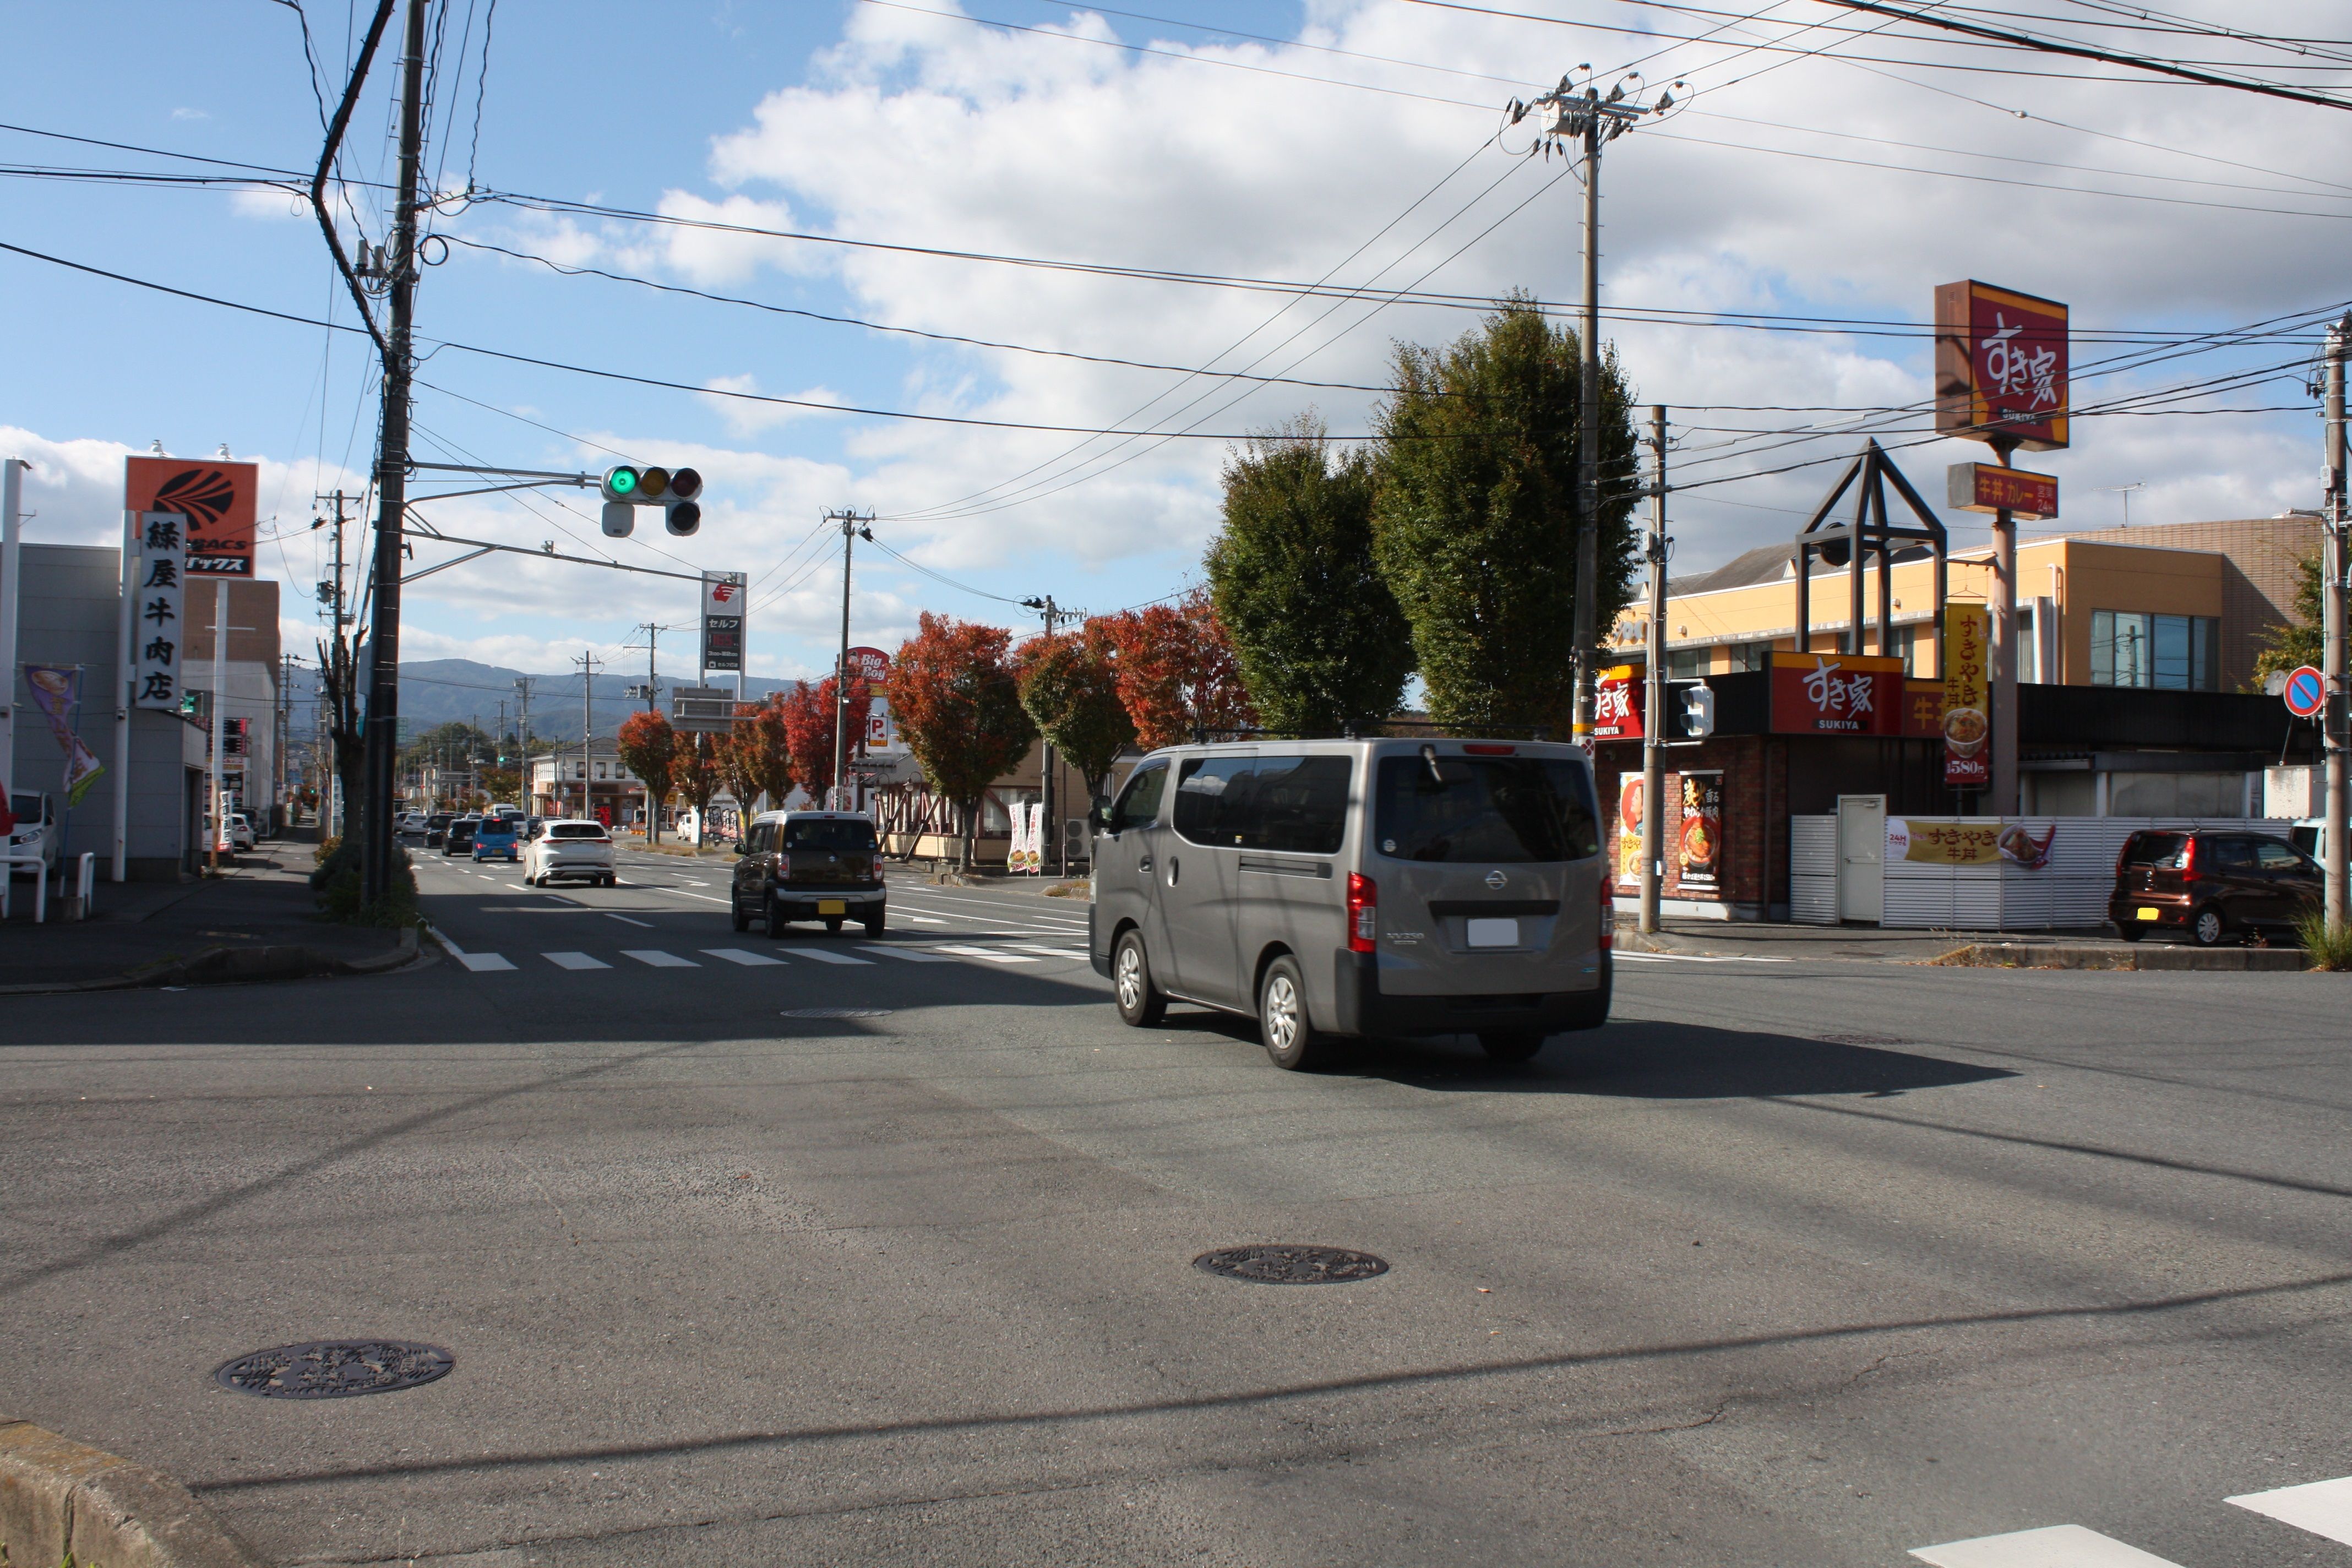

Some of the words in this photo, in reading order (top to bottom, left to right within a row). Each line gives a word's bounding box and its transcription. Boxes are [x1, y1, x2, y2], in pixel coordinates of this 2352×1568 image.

[1981, 312, 2057, 410] すき家
[2002, 409, 2037, 425] SUKIYA
[1979, 476, 2003, 502] 牛丼
[2007, 481, 2034, 504] カレー
[2038, 485, 2053, 498] 営業
[2038, 499, 2054, 513] 24H
[139, 521, 180, 700] 緑屋牛肉店
[709, 619, 738, 629] セルフ
[861, 654, 882, 668] Big
[1959, 614, 1979, 706] すきやき
[862, 666, 886, 680] Boy
[1803, 656, 1874, 719] すき家
[1946, 677, 1959, 707] 牛丼
[872, 720, 884, 733] P
[1594, 726, 1619, 736] SUKIYA
[1819, 720, 1859, 729] SUKIYA
[1929, 828, 1998, 846] すきやき
[1946, 847, 1978, 860] 牛丼
